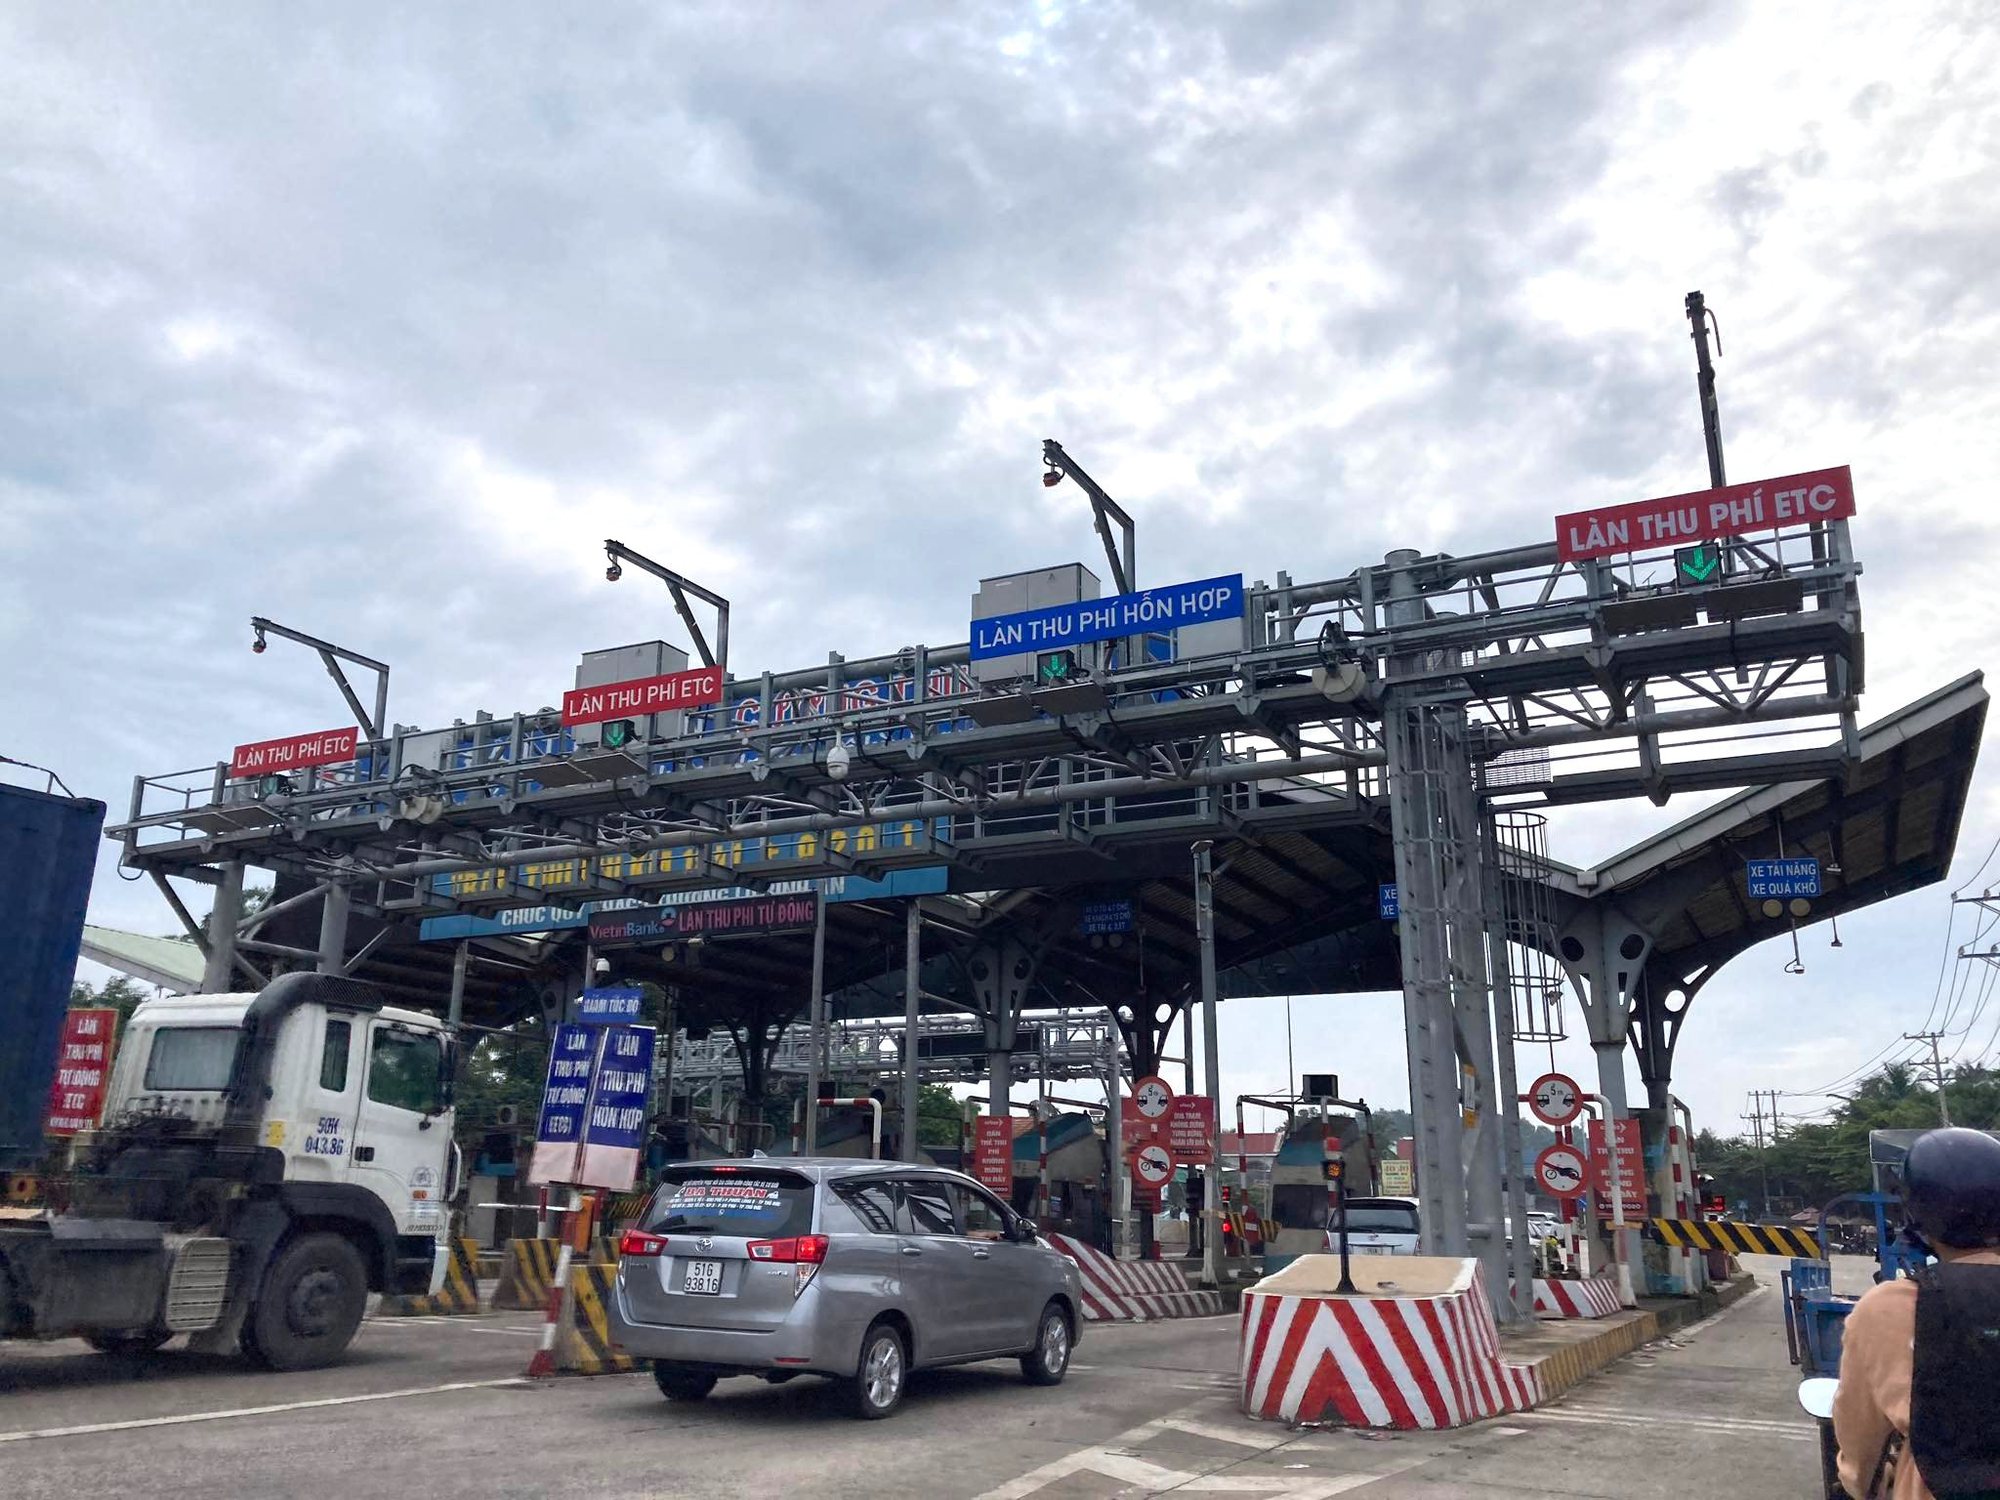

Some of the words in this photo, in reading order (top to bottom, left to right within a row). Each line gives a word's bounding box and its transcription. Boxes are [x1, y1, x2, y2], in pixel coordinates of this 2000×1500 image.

[1570, 516, 1628, 552] LÀN
[1637, 507, 1698, 541] THU
[1709, 487, 1764, 530] PHÍ
[1774, 484, 1837, 518] ETC
[979, 620, 1022, 649] LÀN
[1028, 616, 1072, 641] THU
[1079, 602, 1117, 633] PHÍ
[1124, 590, 1173, 624] HỖN
[1181, 587, 1231, 618] HỢP
[569, 693, 602, 717] LÀN
[607, 687, 641, 710] THU
[647, 678, 676, 704] PHÍ
[681, 676, 714, 698] ETC
[237, 747, 264, 769] LÀN
[267, 745, 294, 765] THU
[298, 736, 321, 759] PHÍ
[323, 736, 350, 755] ETC
[1751, 865, 1765, 877] XE
[1767, 861, 1784, 876] TẢI
[1786, 861, 1816, 878] NẶNG
[1384, 889, 1397, 900] XE
[1753, 883, 1766, 895] XE
[1768, 880, 1791, 895] QUÁ
[1794, 876, 1817, 894] KHỔ
[679, 905, 703, 931] LÀN
[706, 906, 731, 929] THU
[1383, 904, 1395, 915] XE
[589, 921, 662, 939] VietinBank
[566, 1029, 587, 1050] LÀN
[616, 1031, 640, 1056] LÀN
[554, 1060, 572, 1077] THU
[602, 1070, 625, 1091] THU
[625, 1068, 646, 1093] PHÍ
[1550, 1085, 1556, 1096] 5
[618, 1106, 643, 1133] HỢP
[694, 1262, 713, 1277] 51G
[685, 1277, 718, 1292] 938.16
